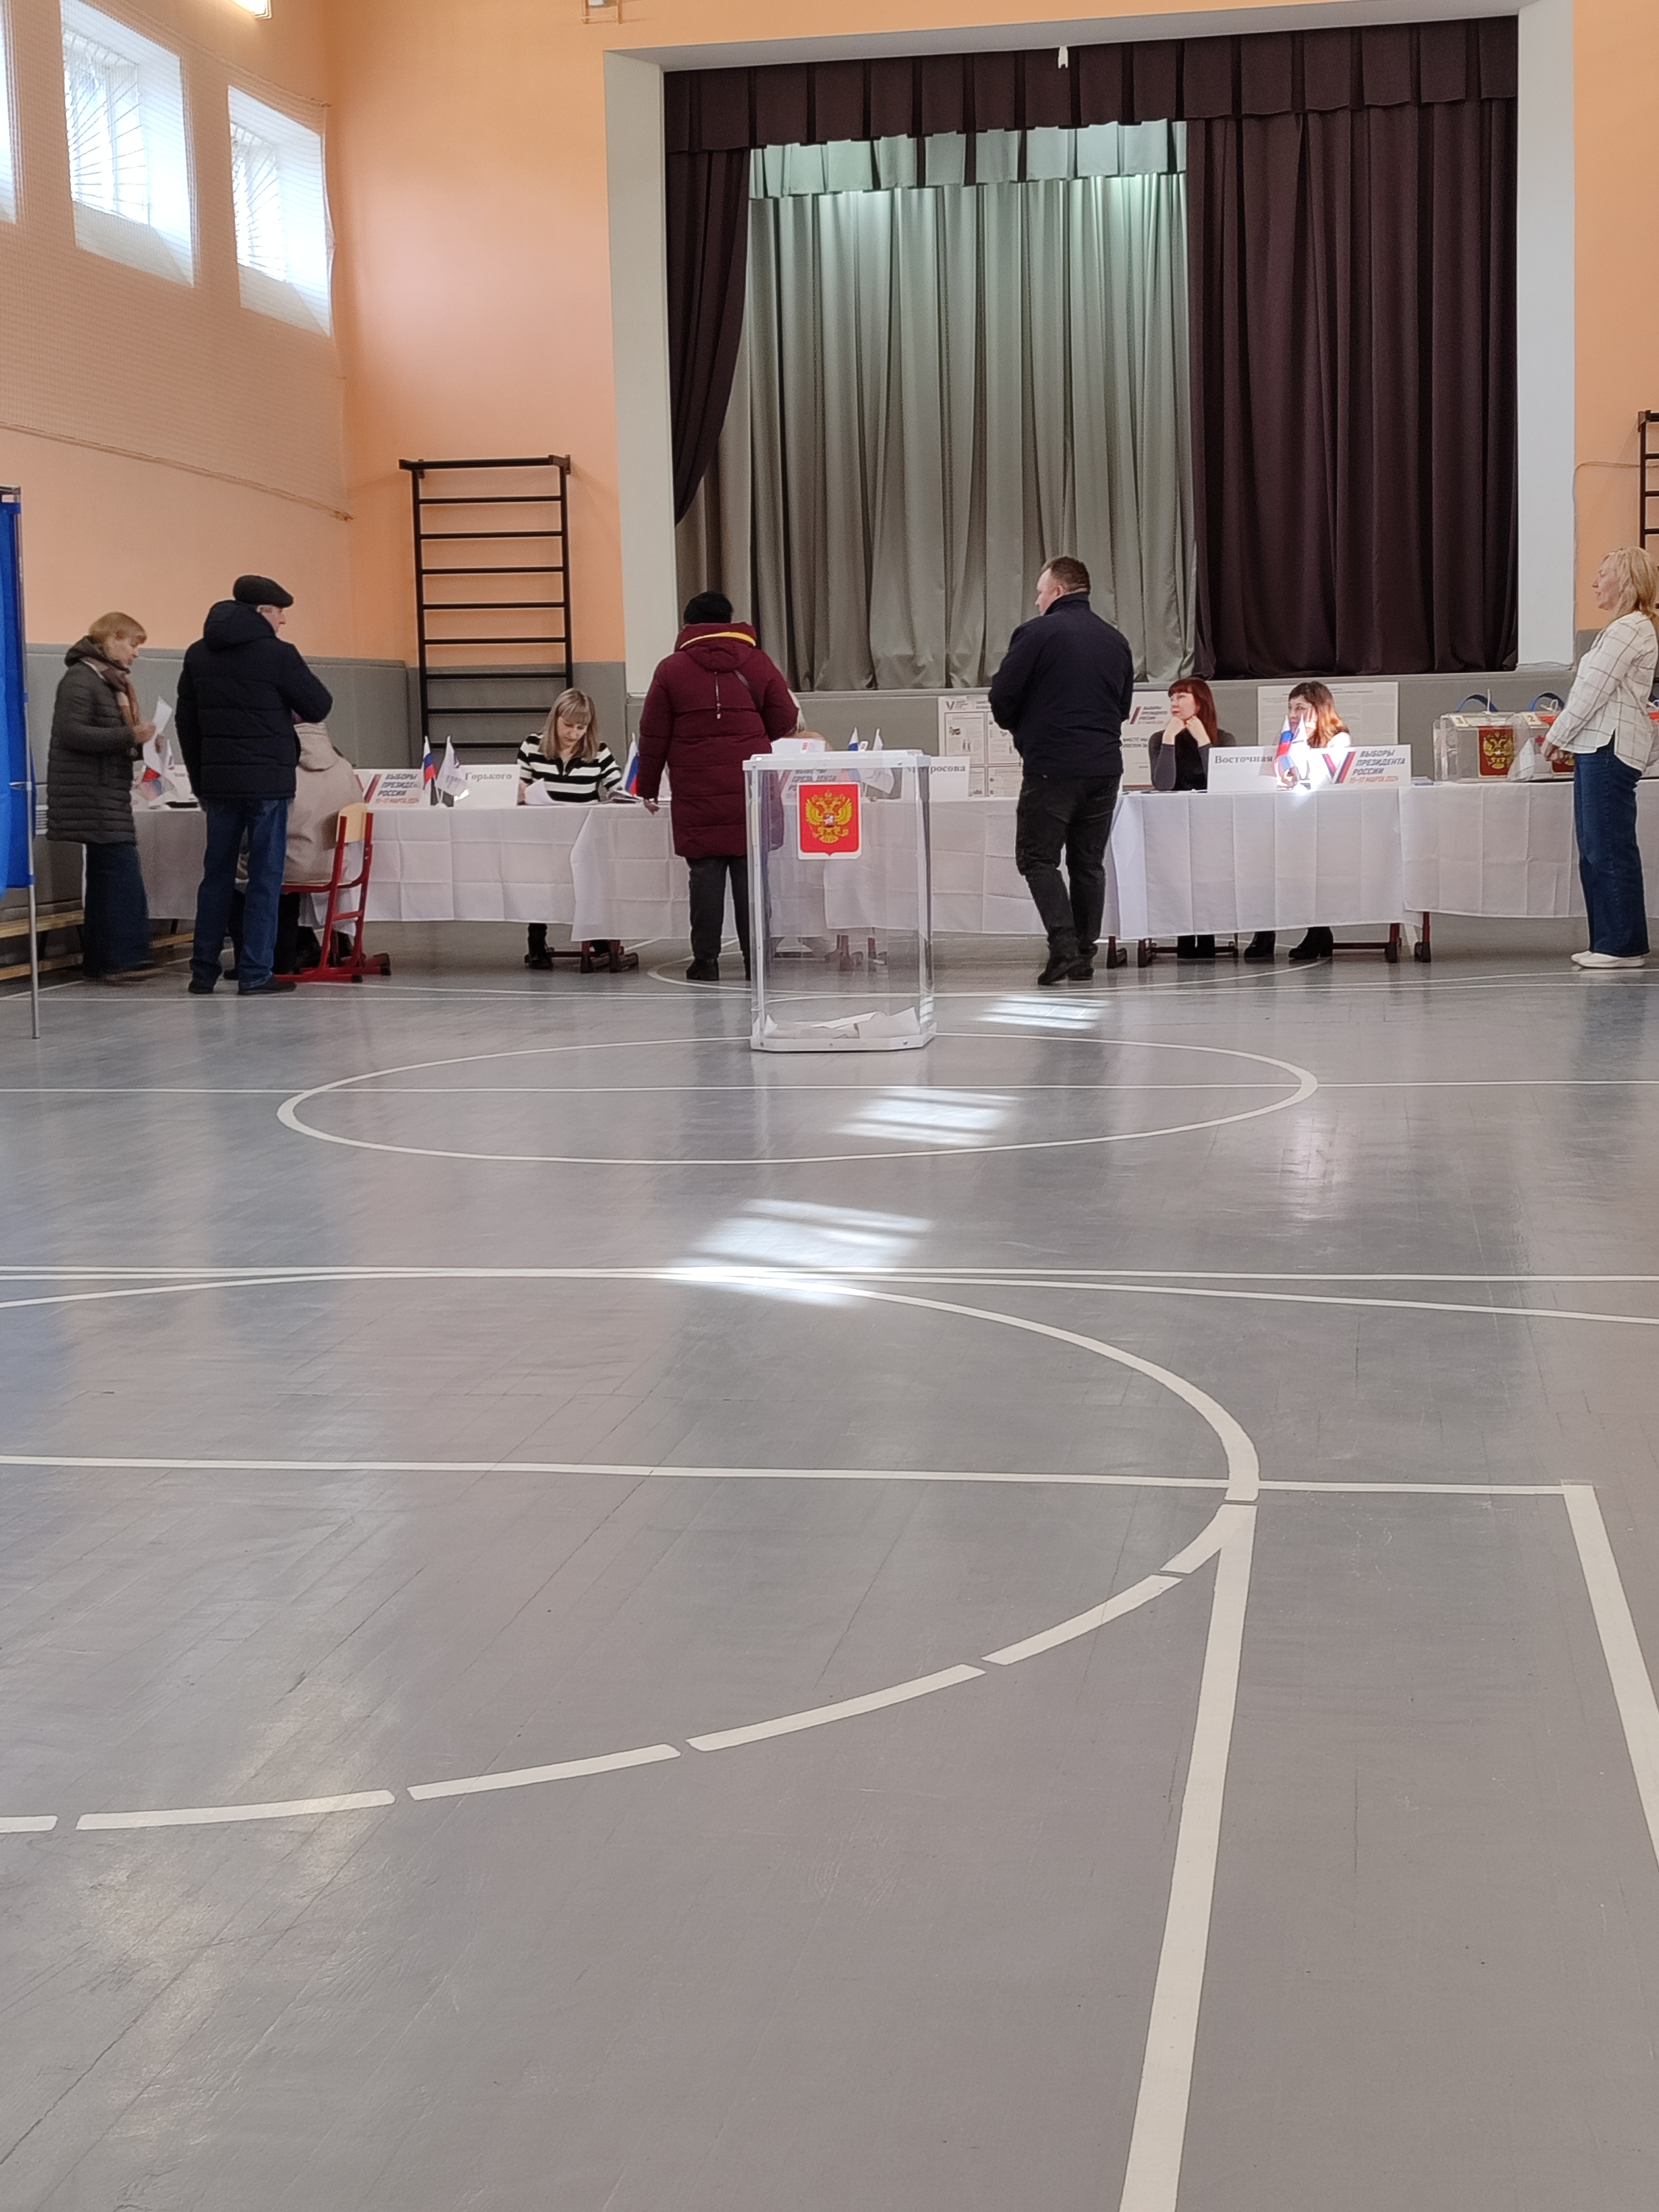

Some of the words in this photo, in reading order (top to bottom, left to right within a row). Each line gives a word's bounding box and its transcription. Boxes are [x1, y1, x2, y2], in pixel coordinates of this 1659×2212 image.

[1214, 755, 1273, 764] Восточная
[1356, 758, 1405, 766] ПРЕЗИДЕНТА
[465, 772, 512, 782] Горького
